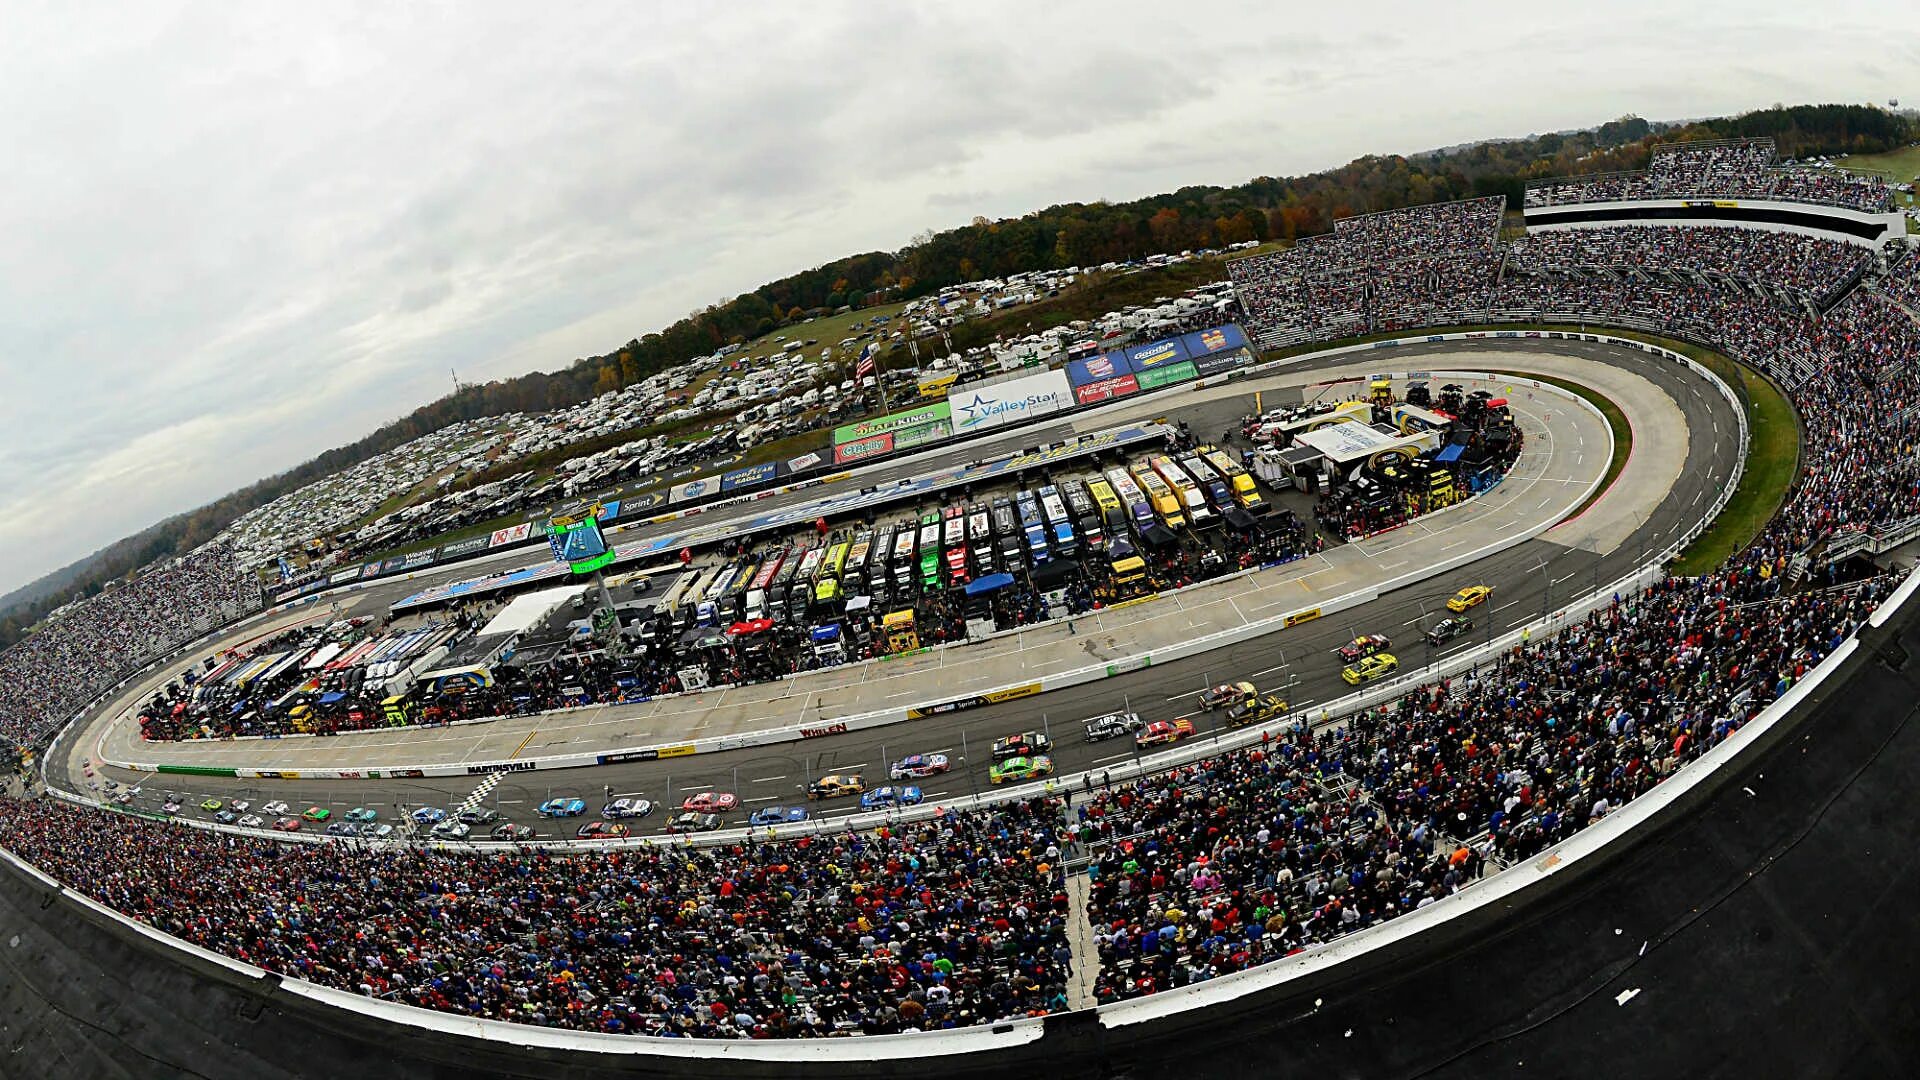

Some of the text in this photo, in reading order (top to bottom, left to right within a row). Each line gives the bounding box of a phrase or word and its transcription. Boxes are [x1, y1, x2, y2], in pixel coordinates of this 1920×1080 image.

[980, 391, 1058, 416] ValleyStar
[623, 498, 651, 512] Sprint
[706, 496, 752, 511] MARTINSVILLE
[957, 699, 977, 709] Sprint
[799, 722, 847, 737] WHELEN
[467, 761, 536, 774] MARTINSVILLE
